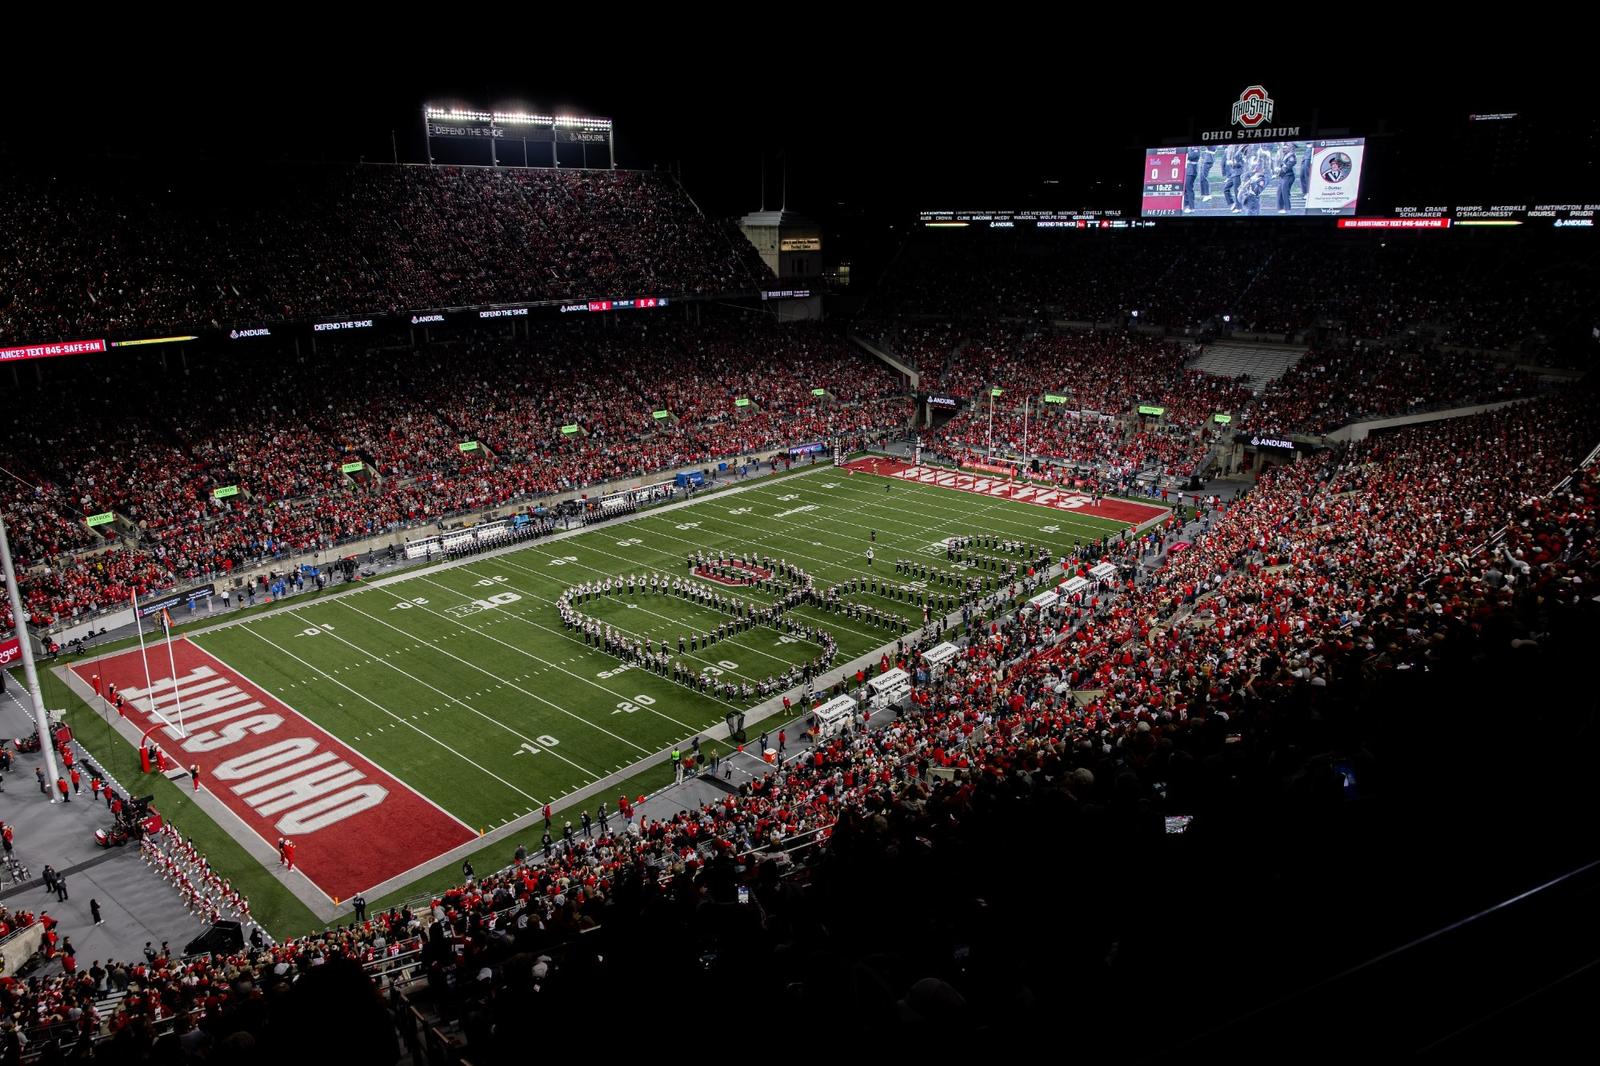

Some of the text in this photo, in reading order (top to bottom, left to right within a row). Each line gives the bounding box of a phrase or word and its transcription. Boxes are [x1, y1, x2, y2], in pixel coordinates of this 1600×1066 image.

[1231, 97, 1274, 125] OHIO STATE
[435, 126, 466, 136] DEFEND
[466, 128, 481, 136] THE
[1201, 127, 1300, 141] OHIO STADIUM
[577, 132, 605, 142] ANDURIL
[1151, 167, 1179, 180] 0 0
[1147, 209, 1176, 217] NETJETS
[479, 310, 501, 318] DEFEND
[501, 309, 512, 317] THE
[566, 304, 588, 312] ANDURIL
[418, 314, 444, 323] ANDURIL
[314, 322, 340, 331] DEFEND
[340, 321, 353, 329] THE
[239, 328, 271, 337] ANDURIL
[27, 348, 45, 357] TEXT
[45, 342, 100, 355] 845-SAFE-FAN
[933, 397, 956, 406] ANDURIL
[1260, 438, 1295, 449] ANDURIL
[928, 646, 950, 658] Spectrum
[875, 673, 900, 686] Spectrum
[616, 694, 656, 714] 20
[820, 700, 848, 714] Spectrum
[520, 734, 560, 755] 10
[211, 736, 390, 836] OHIO
